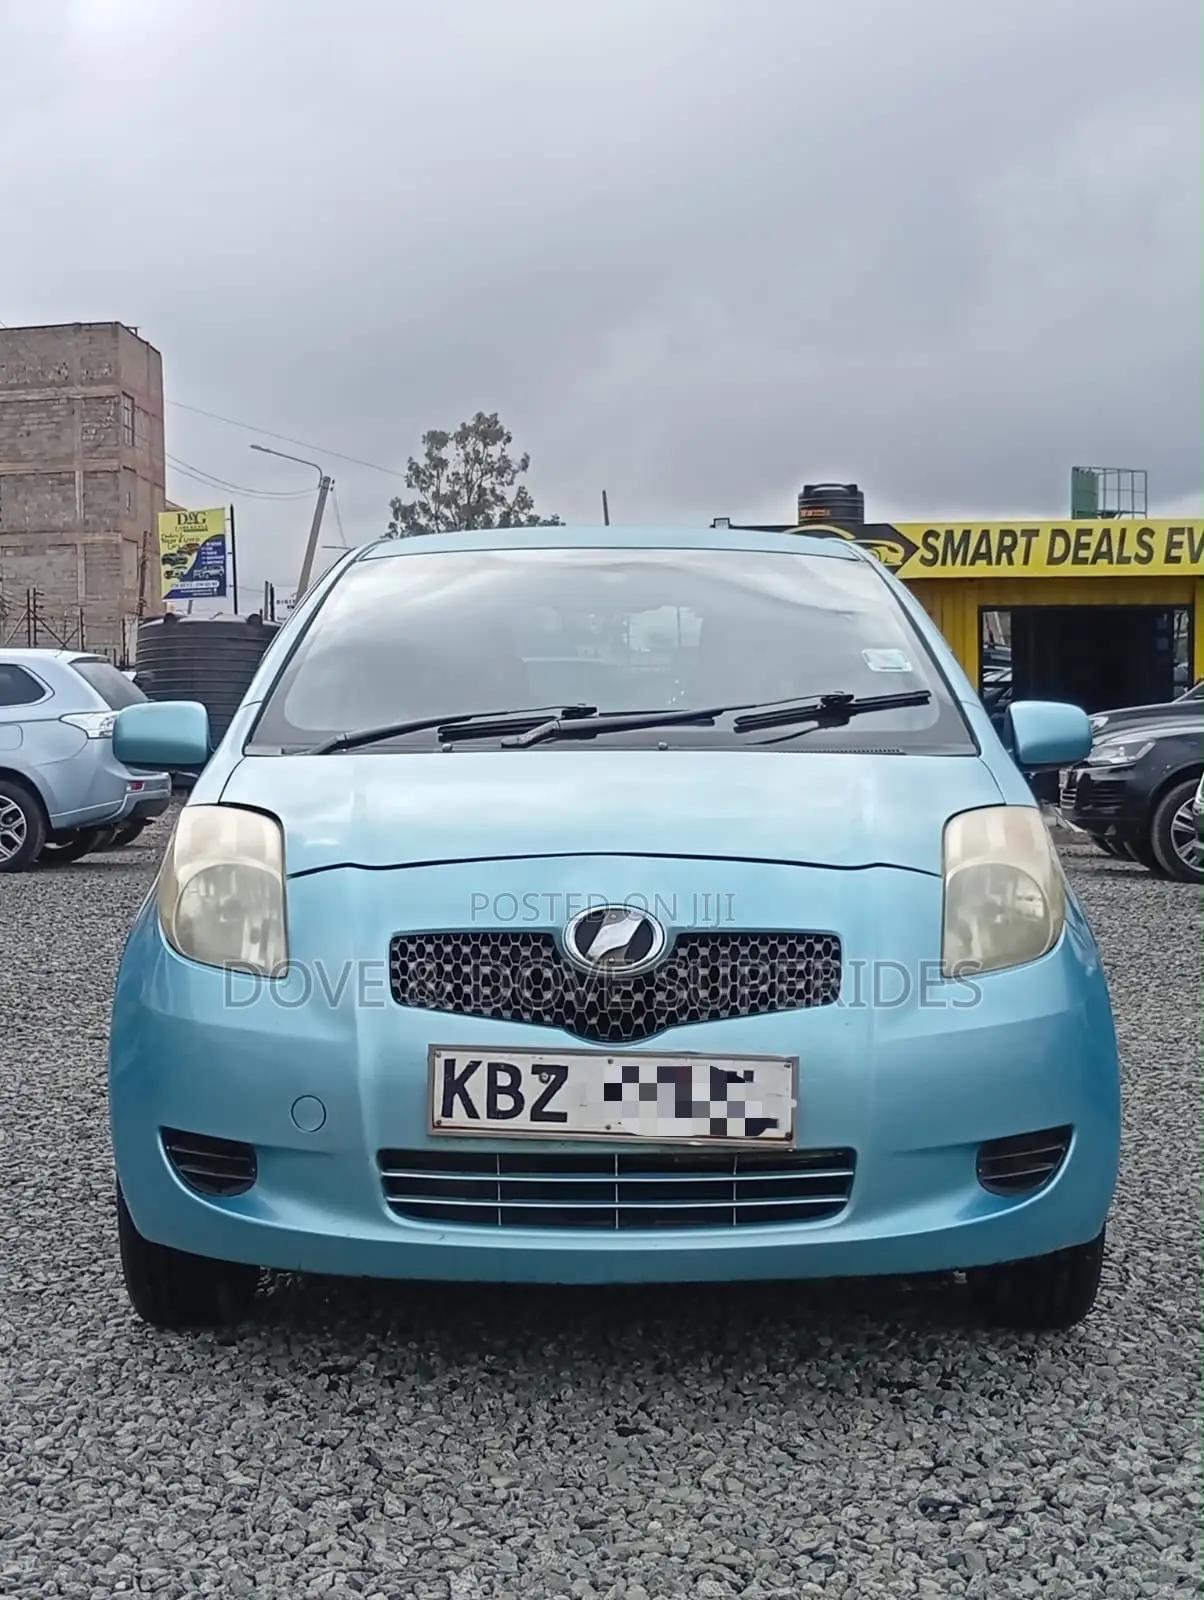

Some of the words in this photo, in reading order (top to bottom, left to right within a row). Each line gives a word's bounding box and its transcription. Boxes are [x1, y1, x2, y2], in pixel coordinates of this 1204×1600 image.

[919, 528, 1040, 567] SMART
[1046, 527, 1156, 566] DEALS
[440, 1058, 569, 1123] KBZ
